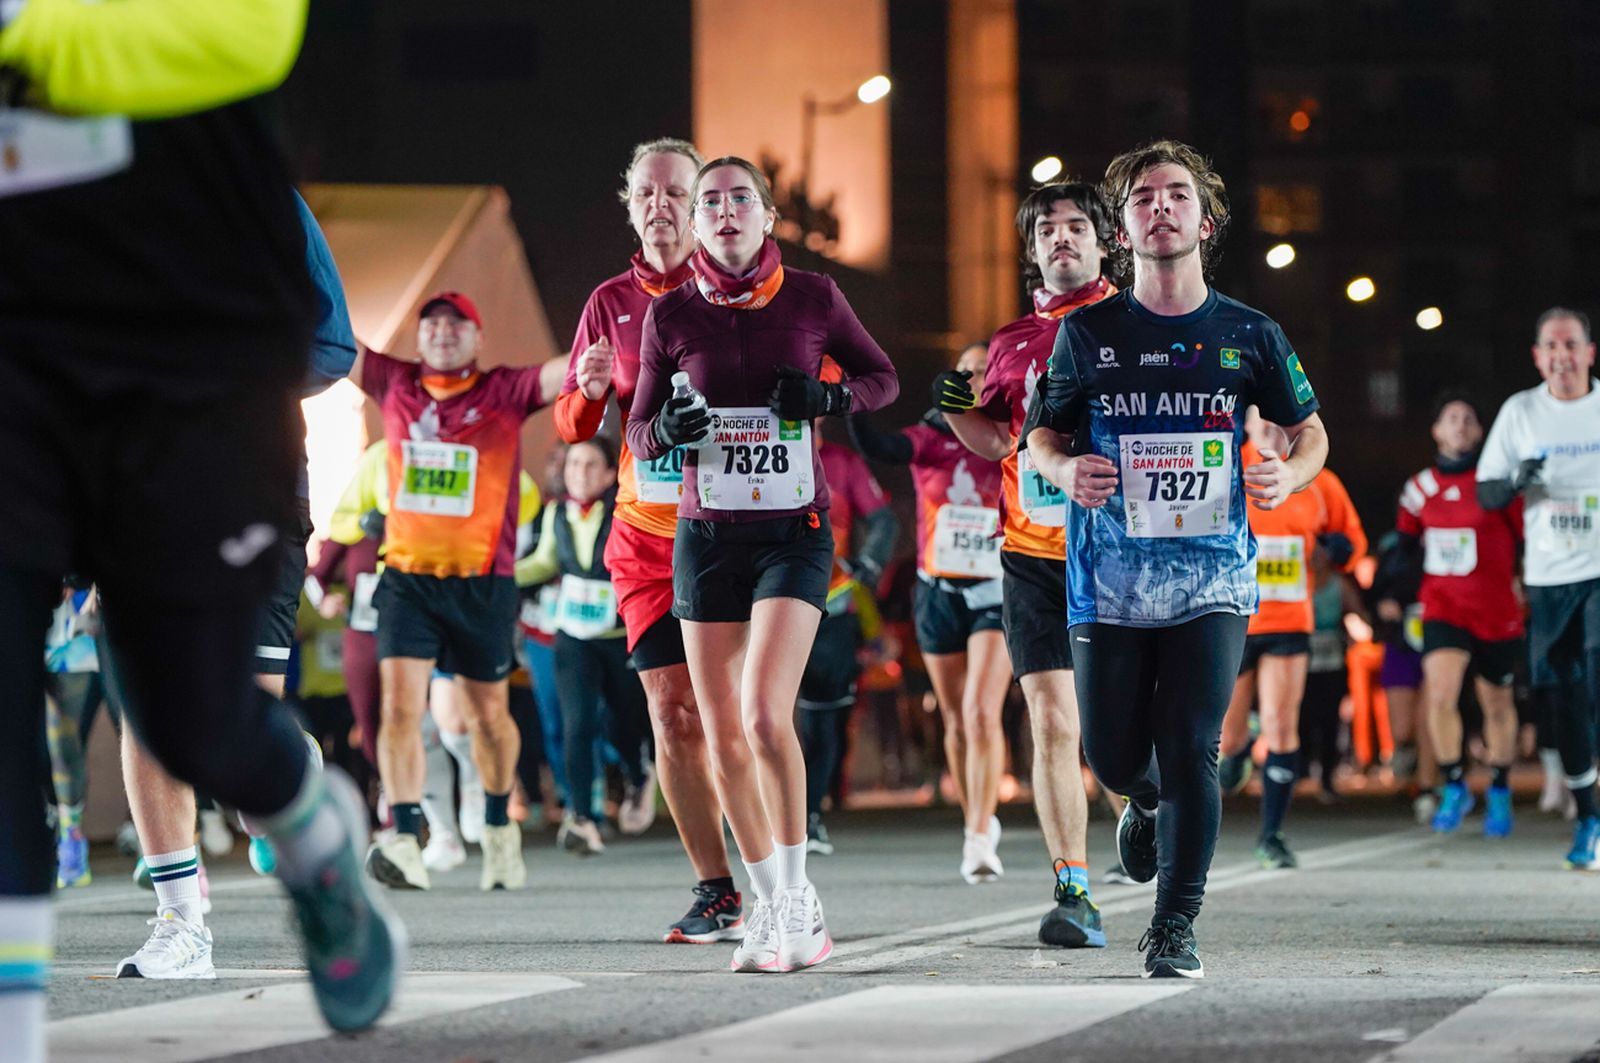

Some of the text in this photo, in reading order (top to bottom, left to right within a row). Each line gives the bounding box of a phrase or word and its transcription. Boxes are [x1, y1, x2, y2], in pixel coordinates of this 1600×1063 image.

[1100, 388, 1237, 417] SAN ANTÓN
[722, 419, 769, 430] NOCHE DE
[734, 428, 770, 443] ANTÓN
[1145, 445, 1194, 456] NOCHE DE
[721, 444, 790, 475] 7328
[1132, 458, 1154, 470] SAN
[1156, 454, 1194, 469] ANTÓN
[414, 469, 458, 489] 2147
[1145, 471, 1210, 502] 7327
[1168, 504, 1189, 512] Javier
[953, 532, 997, 551] 1599
